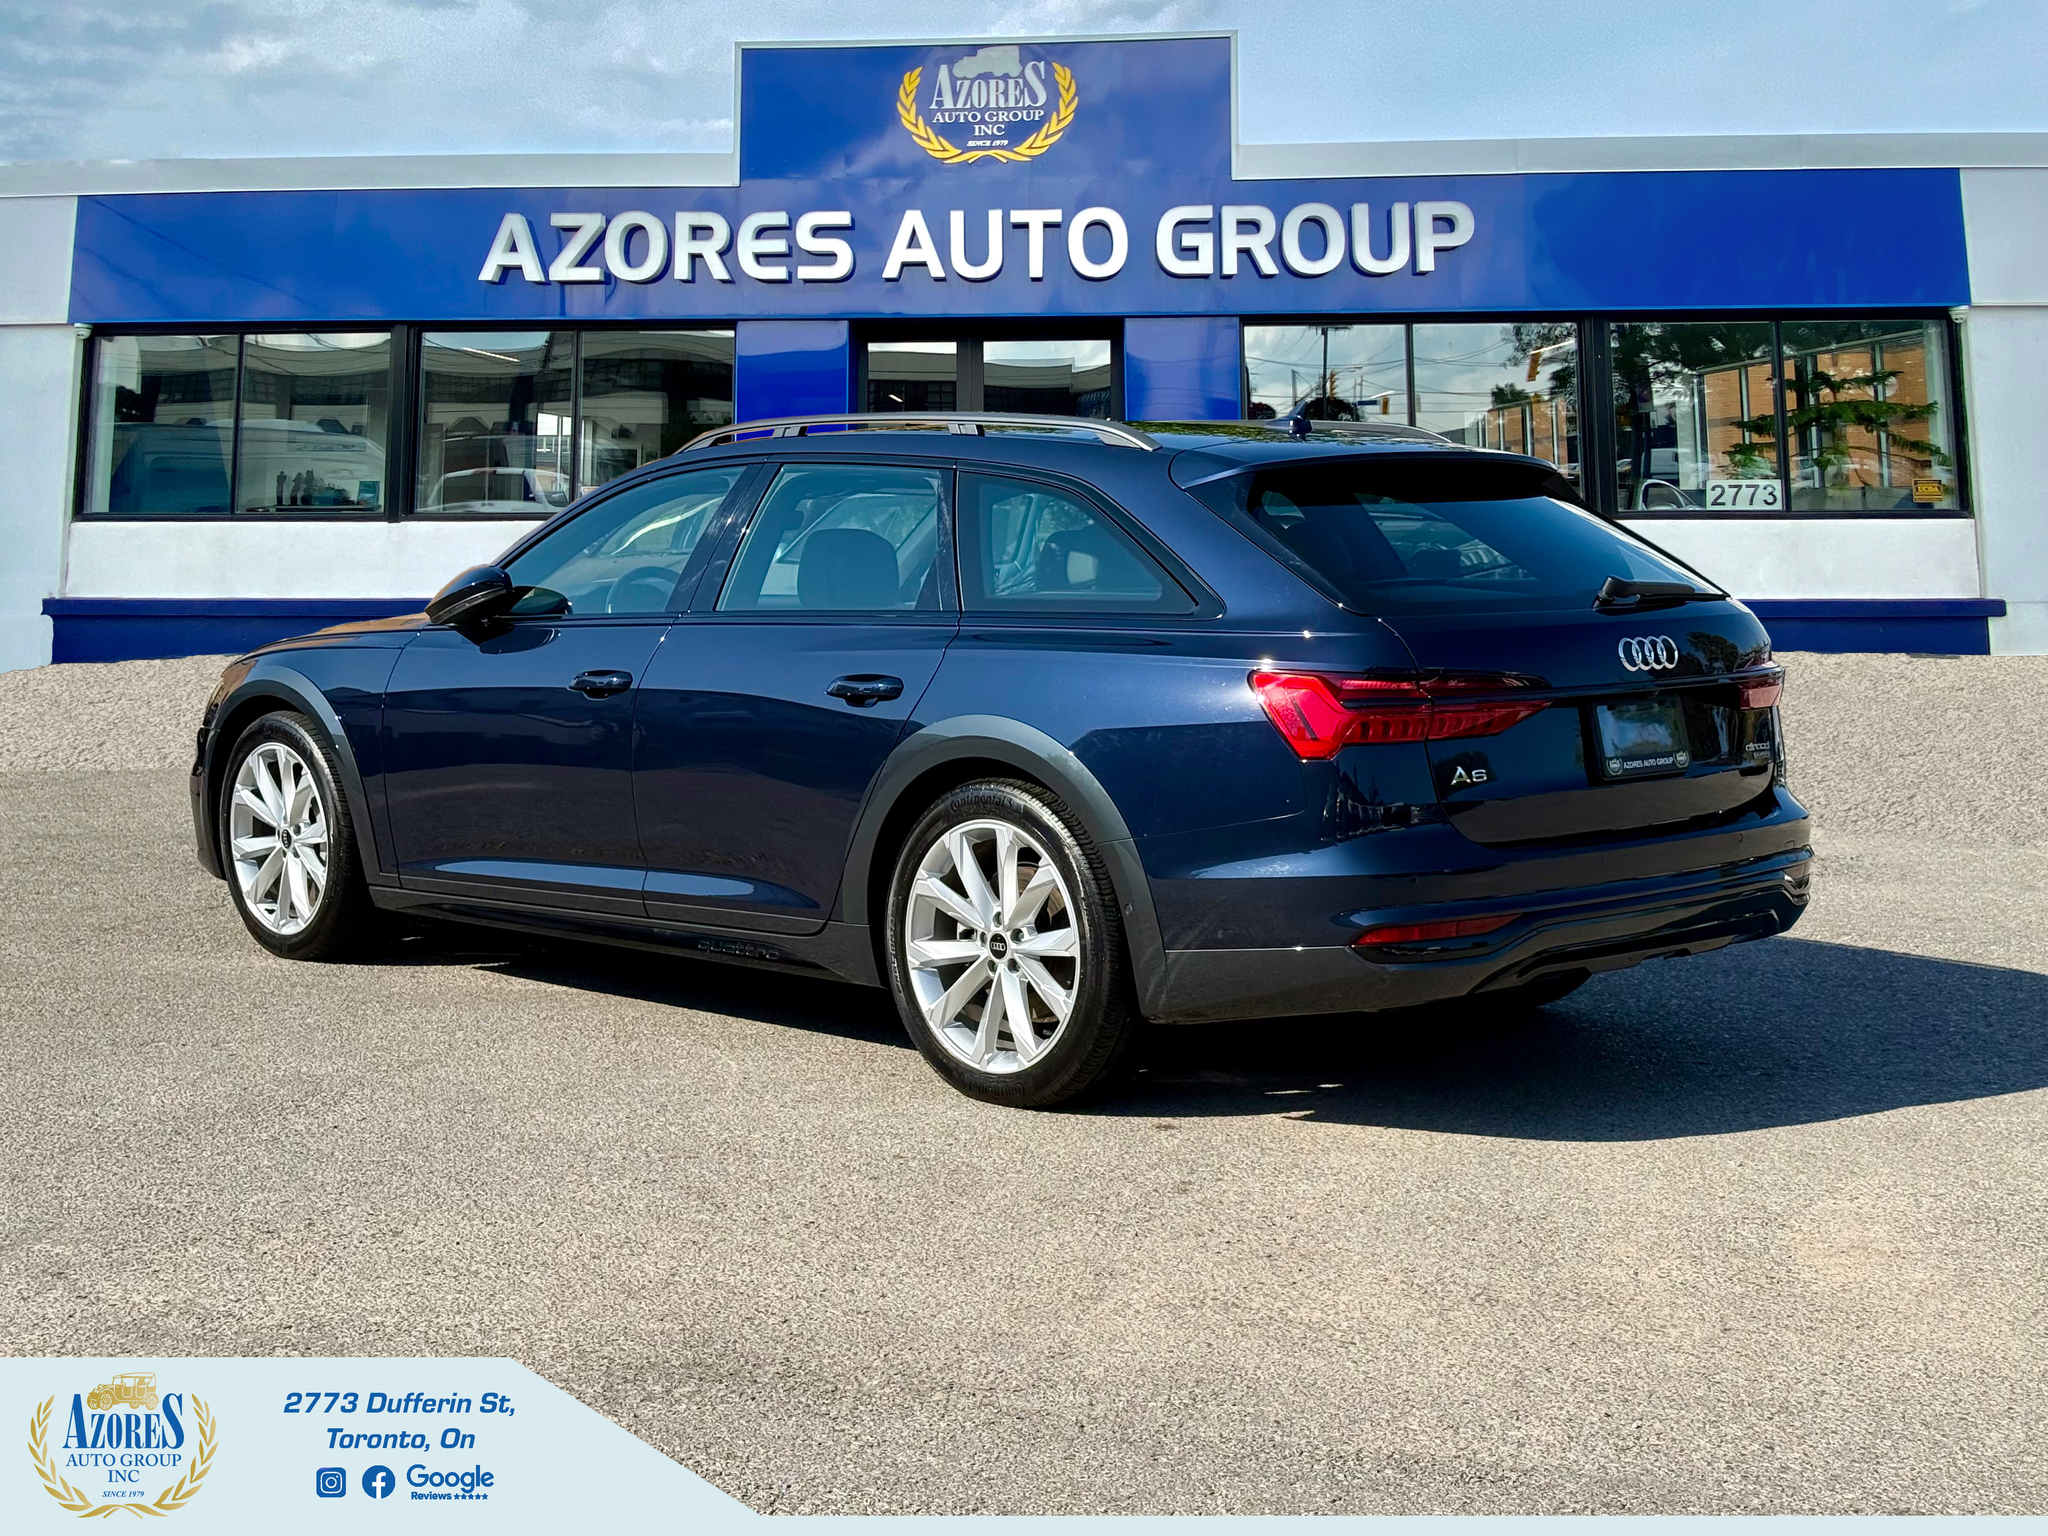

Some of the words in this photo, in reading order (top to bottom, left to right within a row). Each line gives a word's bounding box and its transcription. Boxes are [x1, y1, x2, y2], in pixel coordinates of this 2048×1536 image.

[929, 61, 1048, 110] AZORES
[932, 111, 981, 124] AUTO
[984, 109, 1044, 122] GROUP
[973, 124, 1005, 136] INC
[478, 210, 854, 284] AZORES
[881, 206, 1129, 282] AUTO
[1155, 201, 1475, 278] GROUP
[1710, 484, 1777, 506] 2773
[1623, 760, 1643, 769] AZORES
[1643, 758, 1656, 767] AUTO
[1656, 757, 1673, 766] GROUP
[1451, 765, 1487, 785] A6
[951, 793, 1007, 812] Continental
[698, 939, 780, 960] quattro
